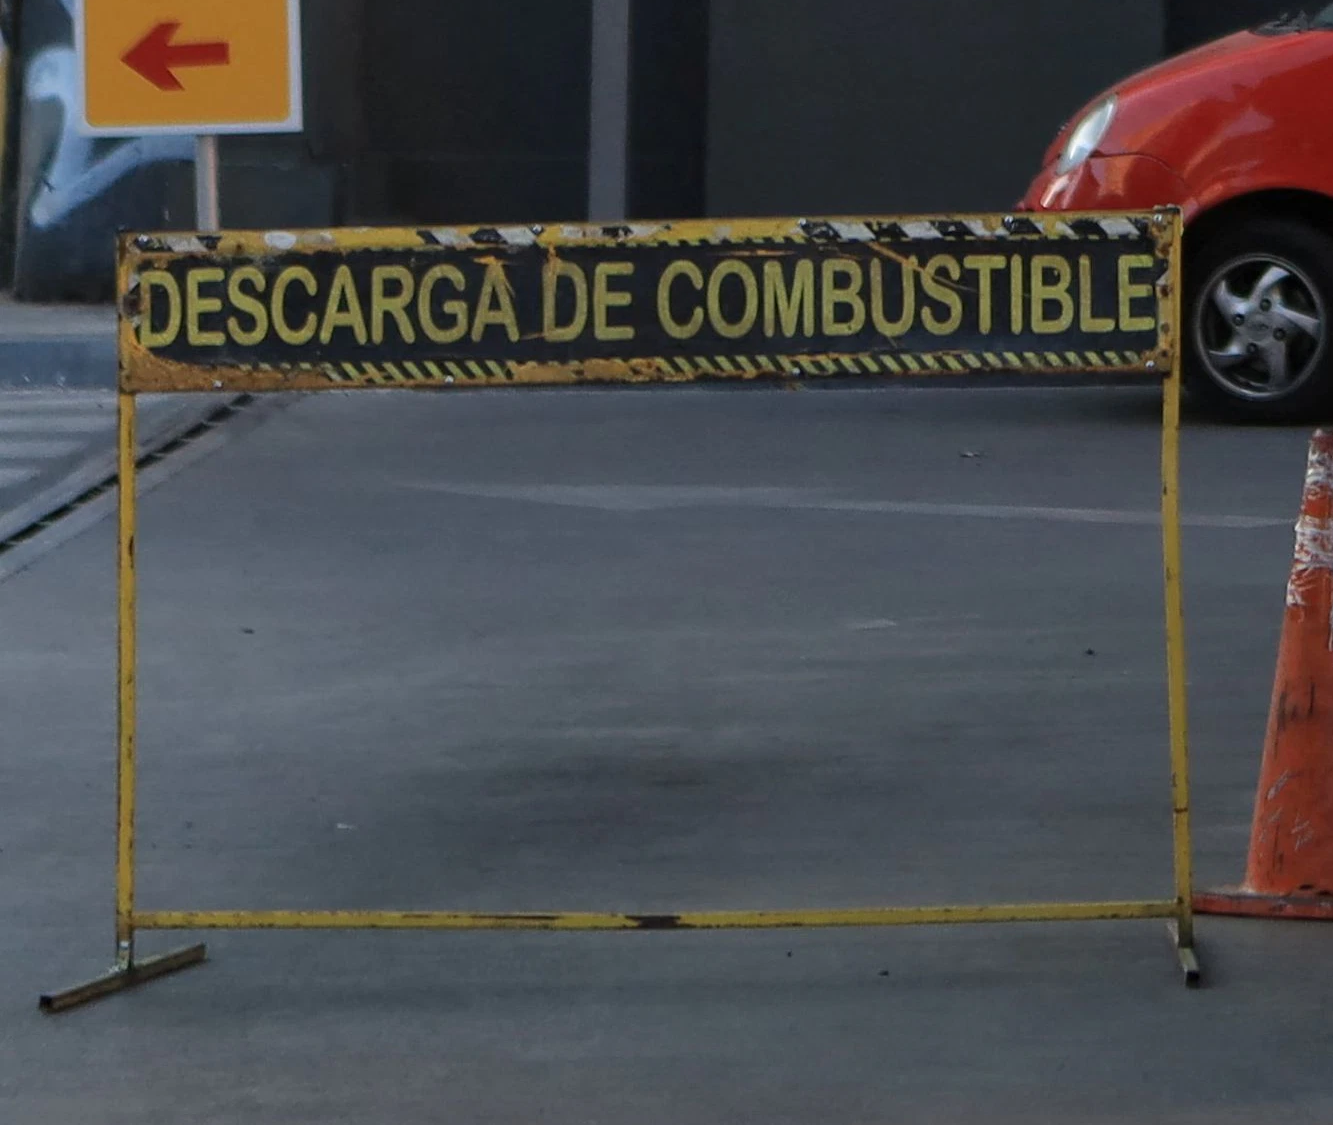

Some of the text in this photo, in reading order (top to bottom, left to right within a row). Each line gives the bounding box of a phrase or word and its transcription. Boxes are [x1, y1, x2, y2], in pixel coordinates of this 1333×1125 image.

[138, 252, 1156, 347] DESCARGA DE COMBUSTIBLE
